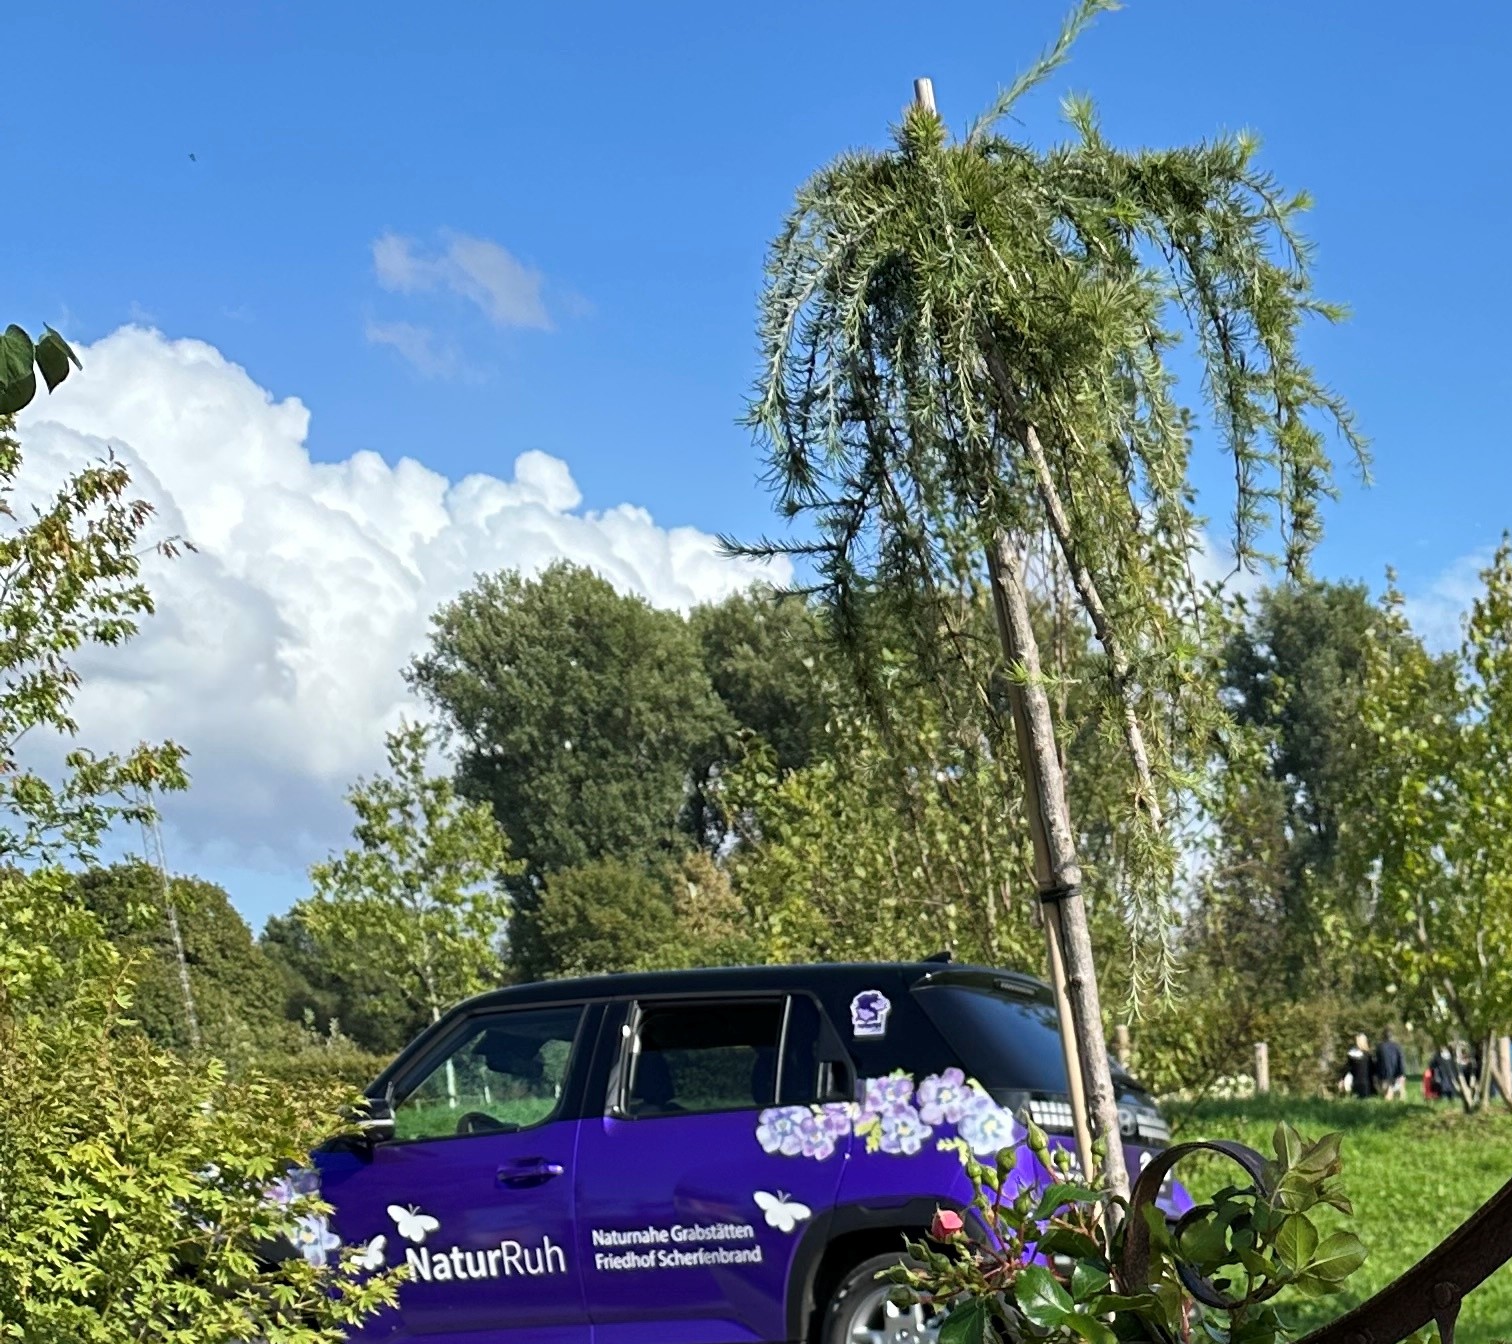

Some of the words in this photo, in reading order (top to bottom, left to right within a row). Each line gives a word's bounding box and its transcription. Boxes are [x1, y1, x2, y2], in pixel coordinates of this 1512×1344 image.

[592, 1226, 669, 1246] Naturnahe
[670, 1223, 754, 1243] Grabstätten
[405, 1235, 566, 1284] NaturRuh
[595, 1250, 656, 1270] Friedhof
[657, 1245, 763, 1268] Scherfenbrand
